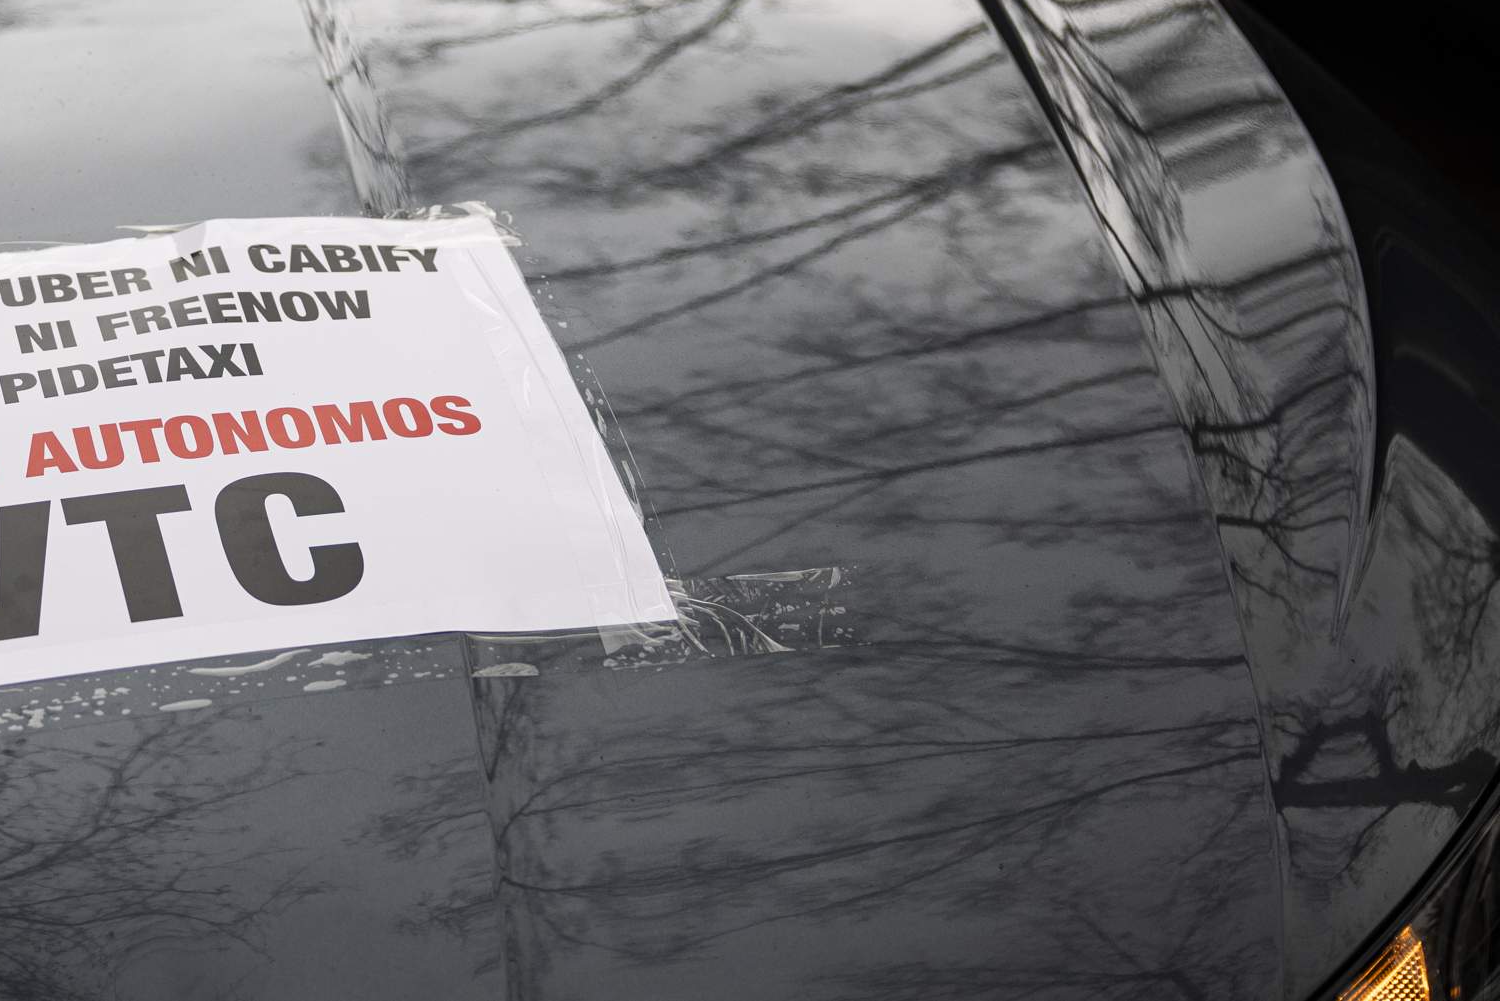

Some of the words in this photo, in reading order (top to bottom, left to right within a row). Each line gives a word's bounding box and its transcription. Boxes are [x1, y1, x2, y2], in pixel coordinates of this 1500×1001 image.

[170, 245, 231, 284] NI
[246, 243, 442, 276] CABIFY
[14, 319, 78, 355] NI
[96, 289, 372, 344] FREENOW
[24, 395, 483, 479] AUTONOMOS
